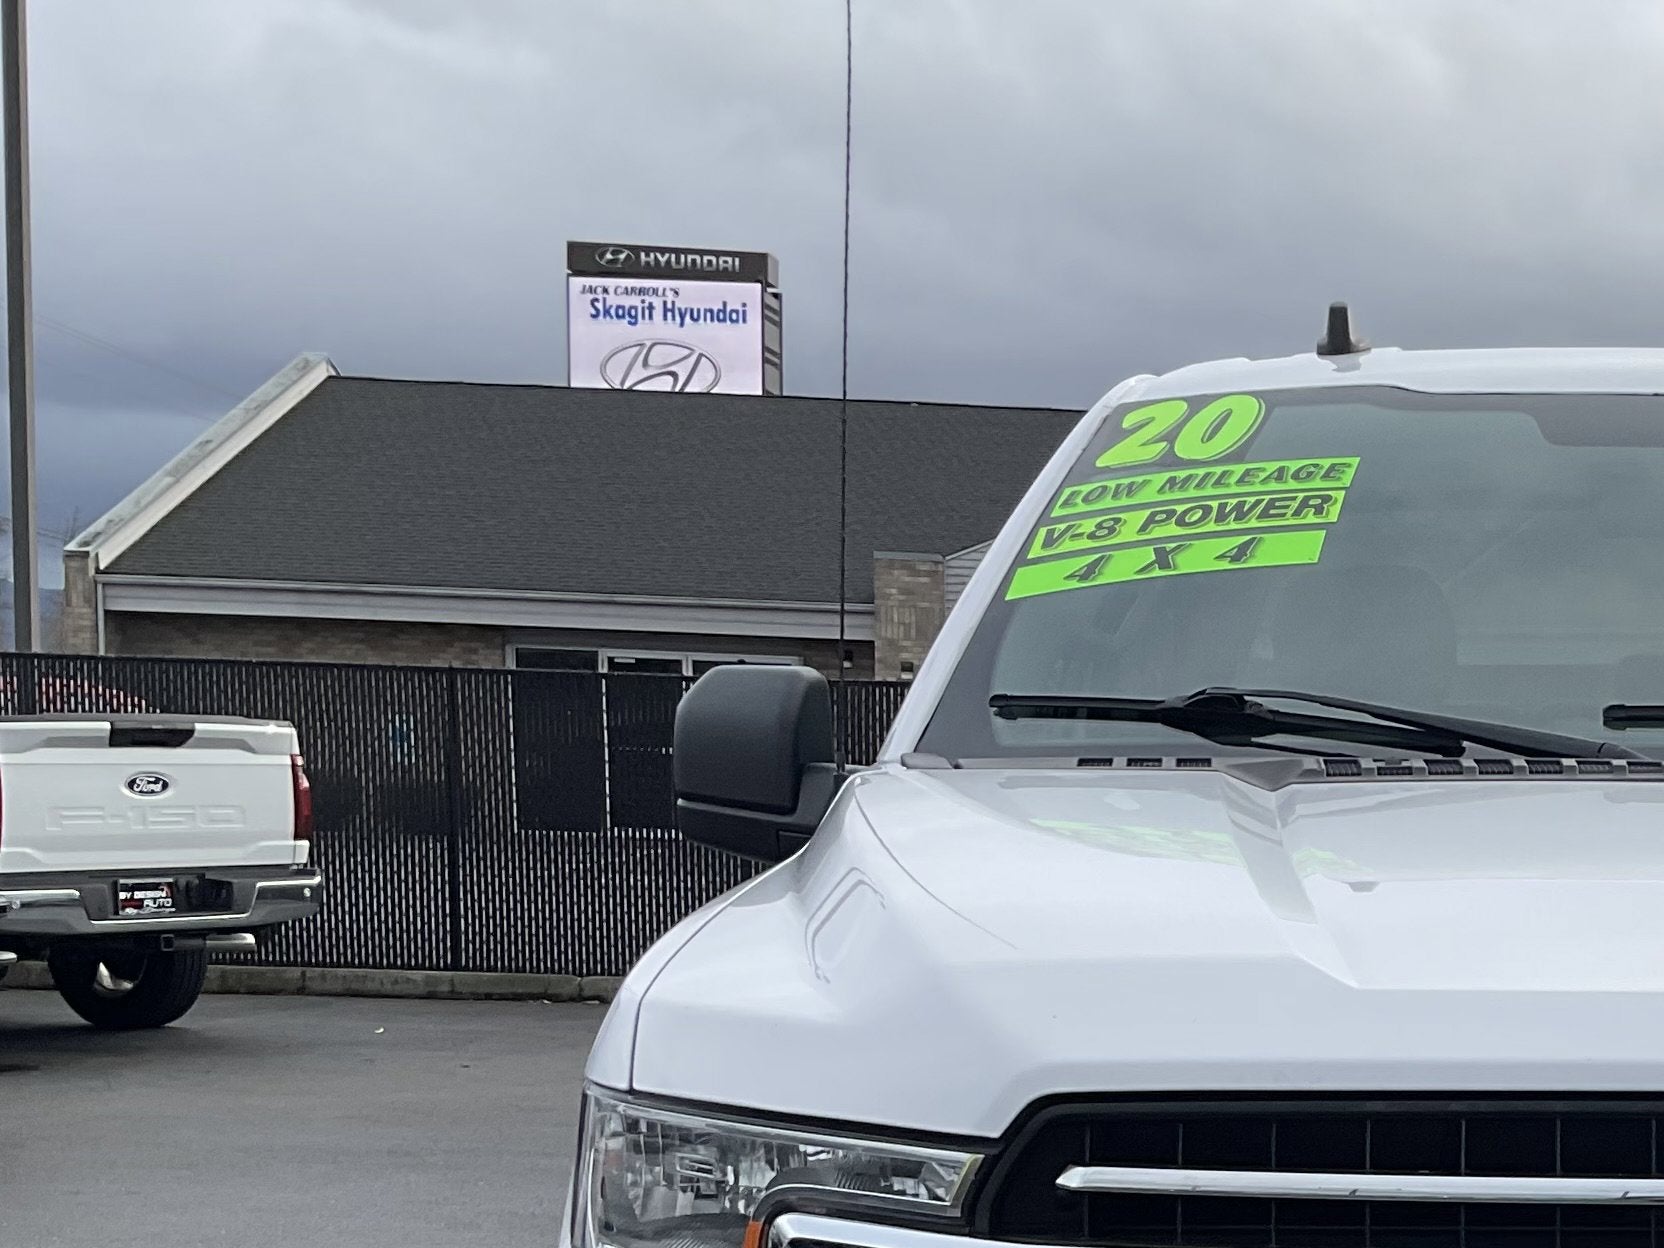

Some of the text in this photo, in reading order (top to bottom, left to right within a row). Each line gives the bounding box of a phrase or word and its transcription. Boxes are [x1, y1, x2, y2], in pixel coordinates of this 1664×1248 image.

[640, 251, 740, 272] HYUNDAI
[580, 284, 681, 298] JACK CARROLL'S
[589, 298, 748, 328] Skagit Hyundai
[1095, 394, 1266, 468] 20
[1058, 462, 1352, 510] LOW MILEAGE
[1041, 493, 1337, 551] V-8 POWER
[1064, 536, 1264, 584] 4 X 4
[133, 777, 164, 792] Ford
[144, 898, 173, 908] AUTO
